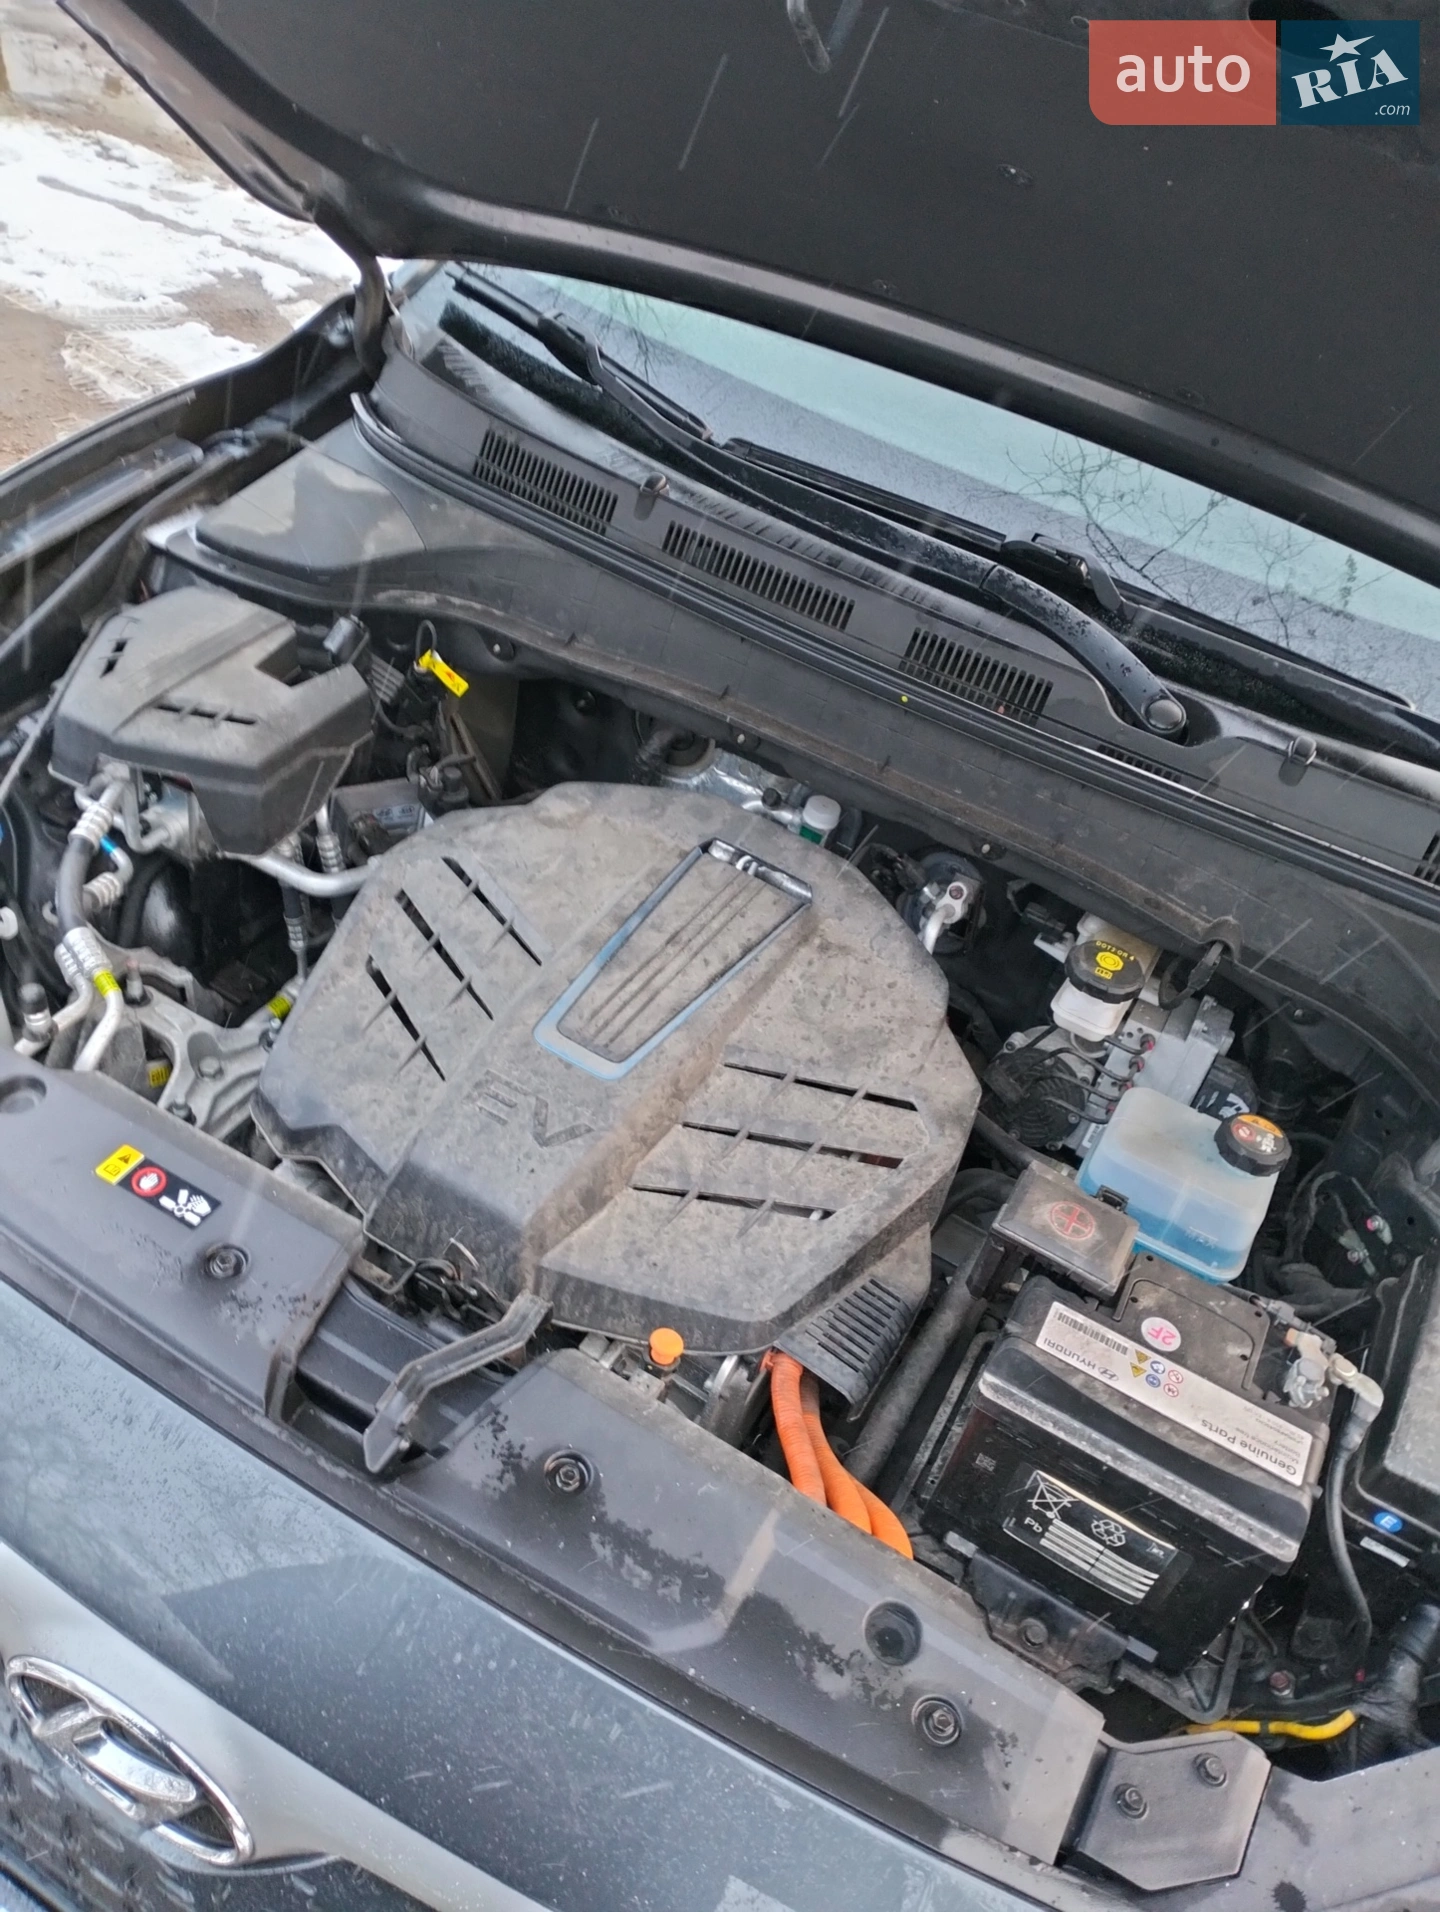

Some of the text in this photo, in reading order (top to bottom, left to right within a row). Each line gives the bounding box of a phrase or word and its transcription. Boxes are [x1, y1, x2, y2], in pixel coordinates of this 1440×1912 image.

[1146, 1325, 1177, 1346] 2F
[1043, 1337, 1096, 1370] HYUNDAI
[1201, 1419, 1237, 1445] Parts
[1240, 1440, 1297, 1476] Genuine
[1024, 1517, 1043, 1533] Pb
